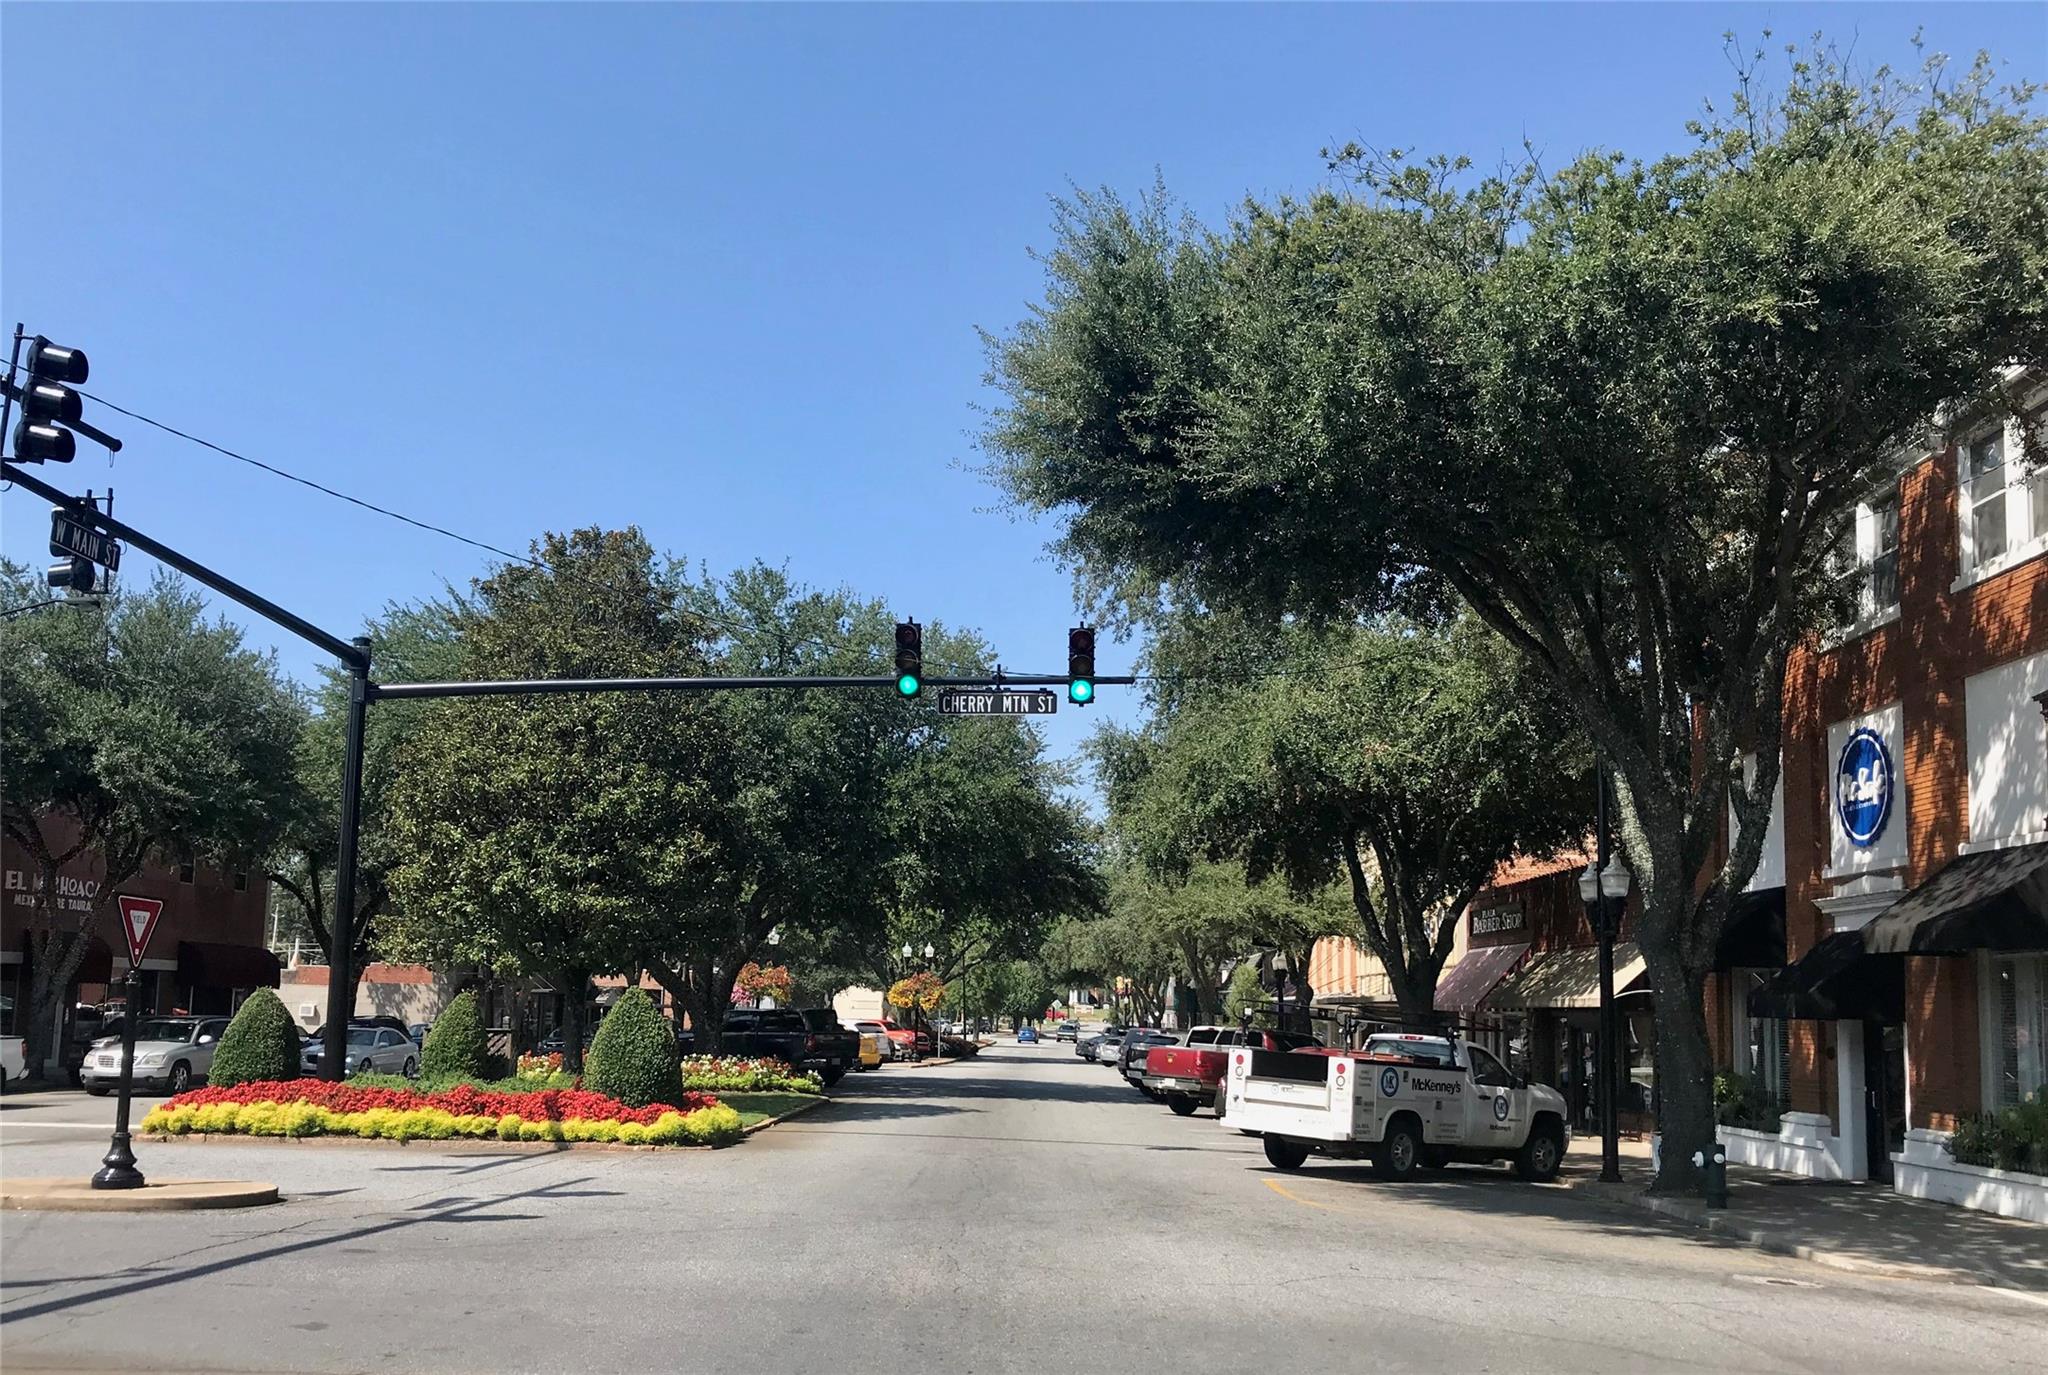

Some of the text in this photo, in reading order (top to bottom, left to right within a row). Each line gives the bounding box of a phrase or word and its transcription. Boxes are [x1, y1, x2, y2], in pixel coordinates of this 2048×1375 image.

[56, 519, 118, 568] W MAIN ST
[942, 695, 1053, 713] CHERRY MTN ST
[5, 870, 101, 898] EL MHOAC
[133, 915, 146, 924] YIELD
[1473, 912, 1522, 934] BARBER SHOP
[1411, 1078, 1462, 1095] McKenney's
